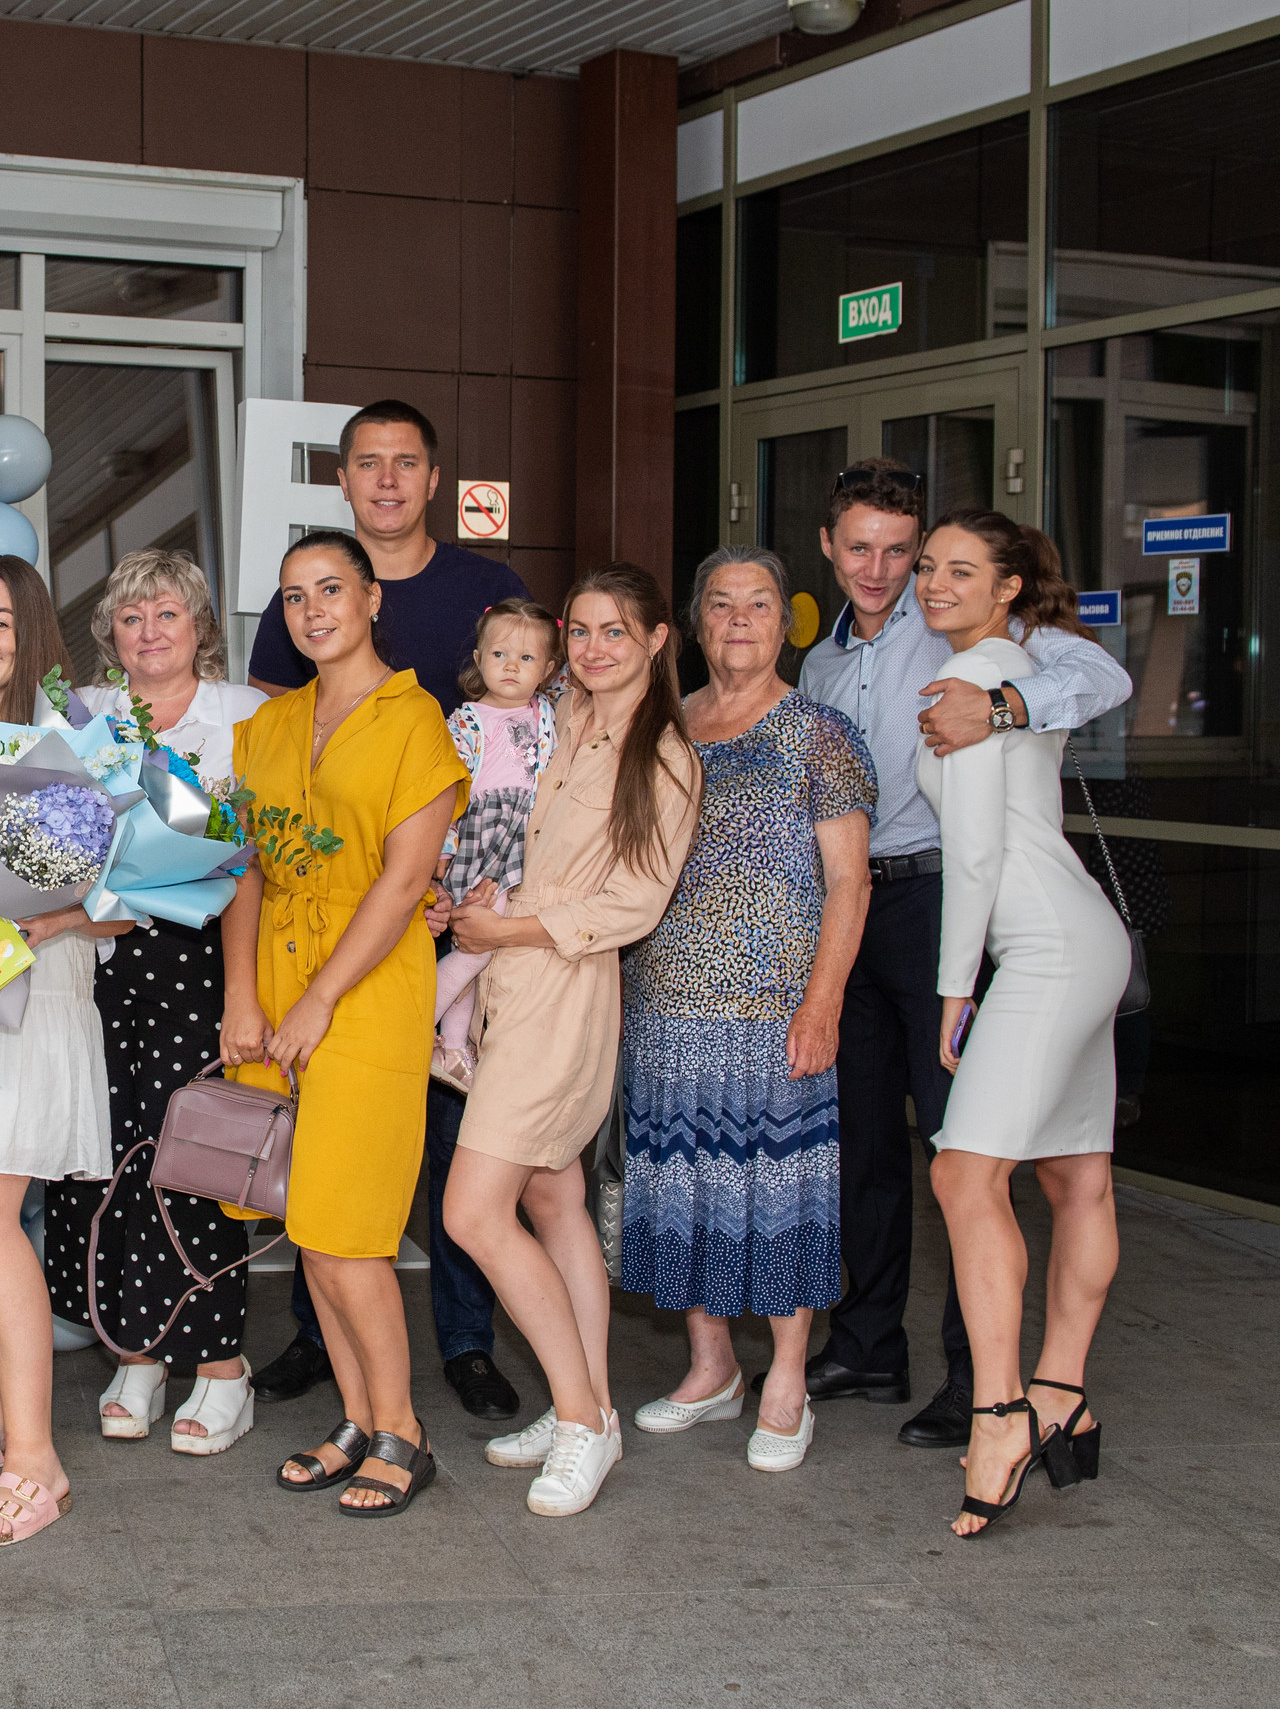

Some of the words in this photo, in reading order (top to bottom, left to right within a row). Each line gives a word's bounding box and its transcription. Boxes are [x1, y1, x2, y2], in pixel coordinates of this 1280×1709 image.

[848, 293, 892, 328] ВХОД
[1147, 529, 1183, 542] ПРИЕМНОЕ
[1184, 526, 1224, 540] ОТДЕЛЕНИЕ
